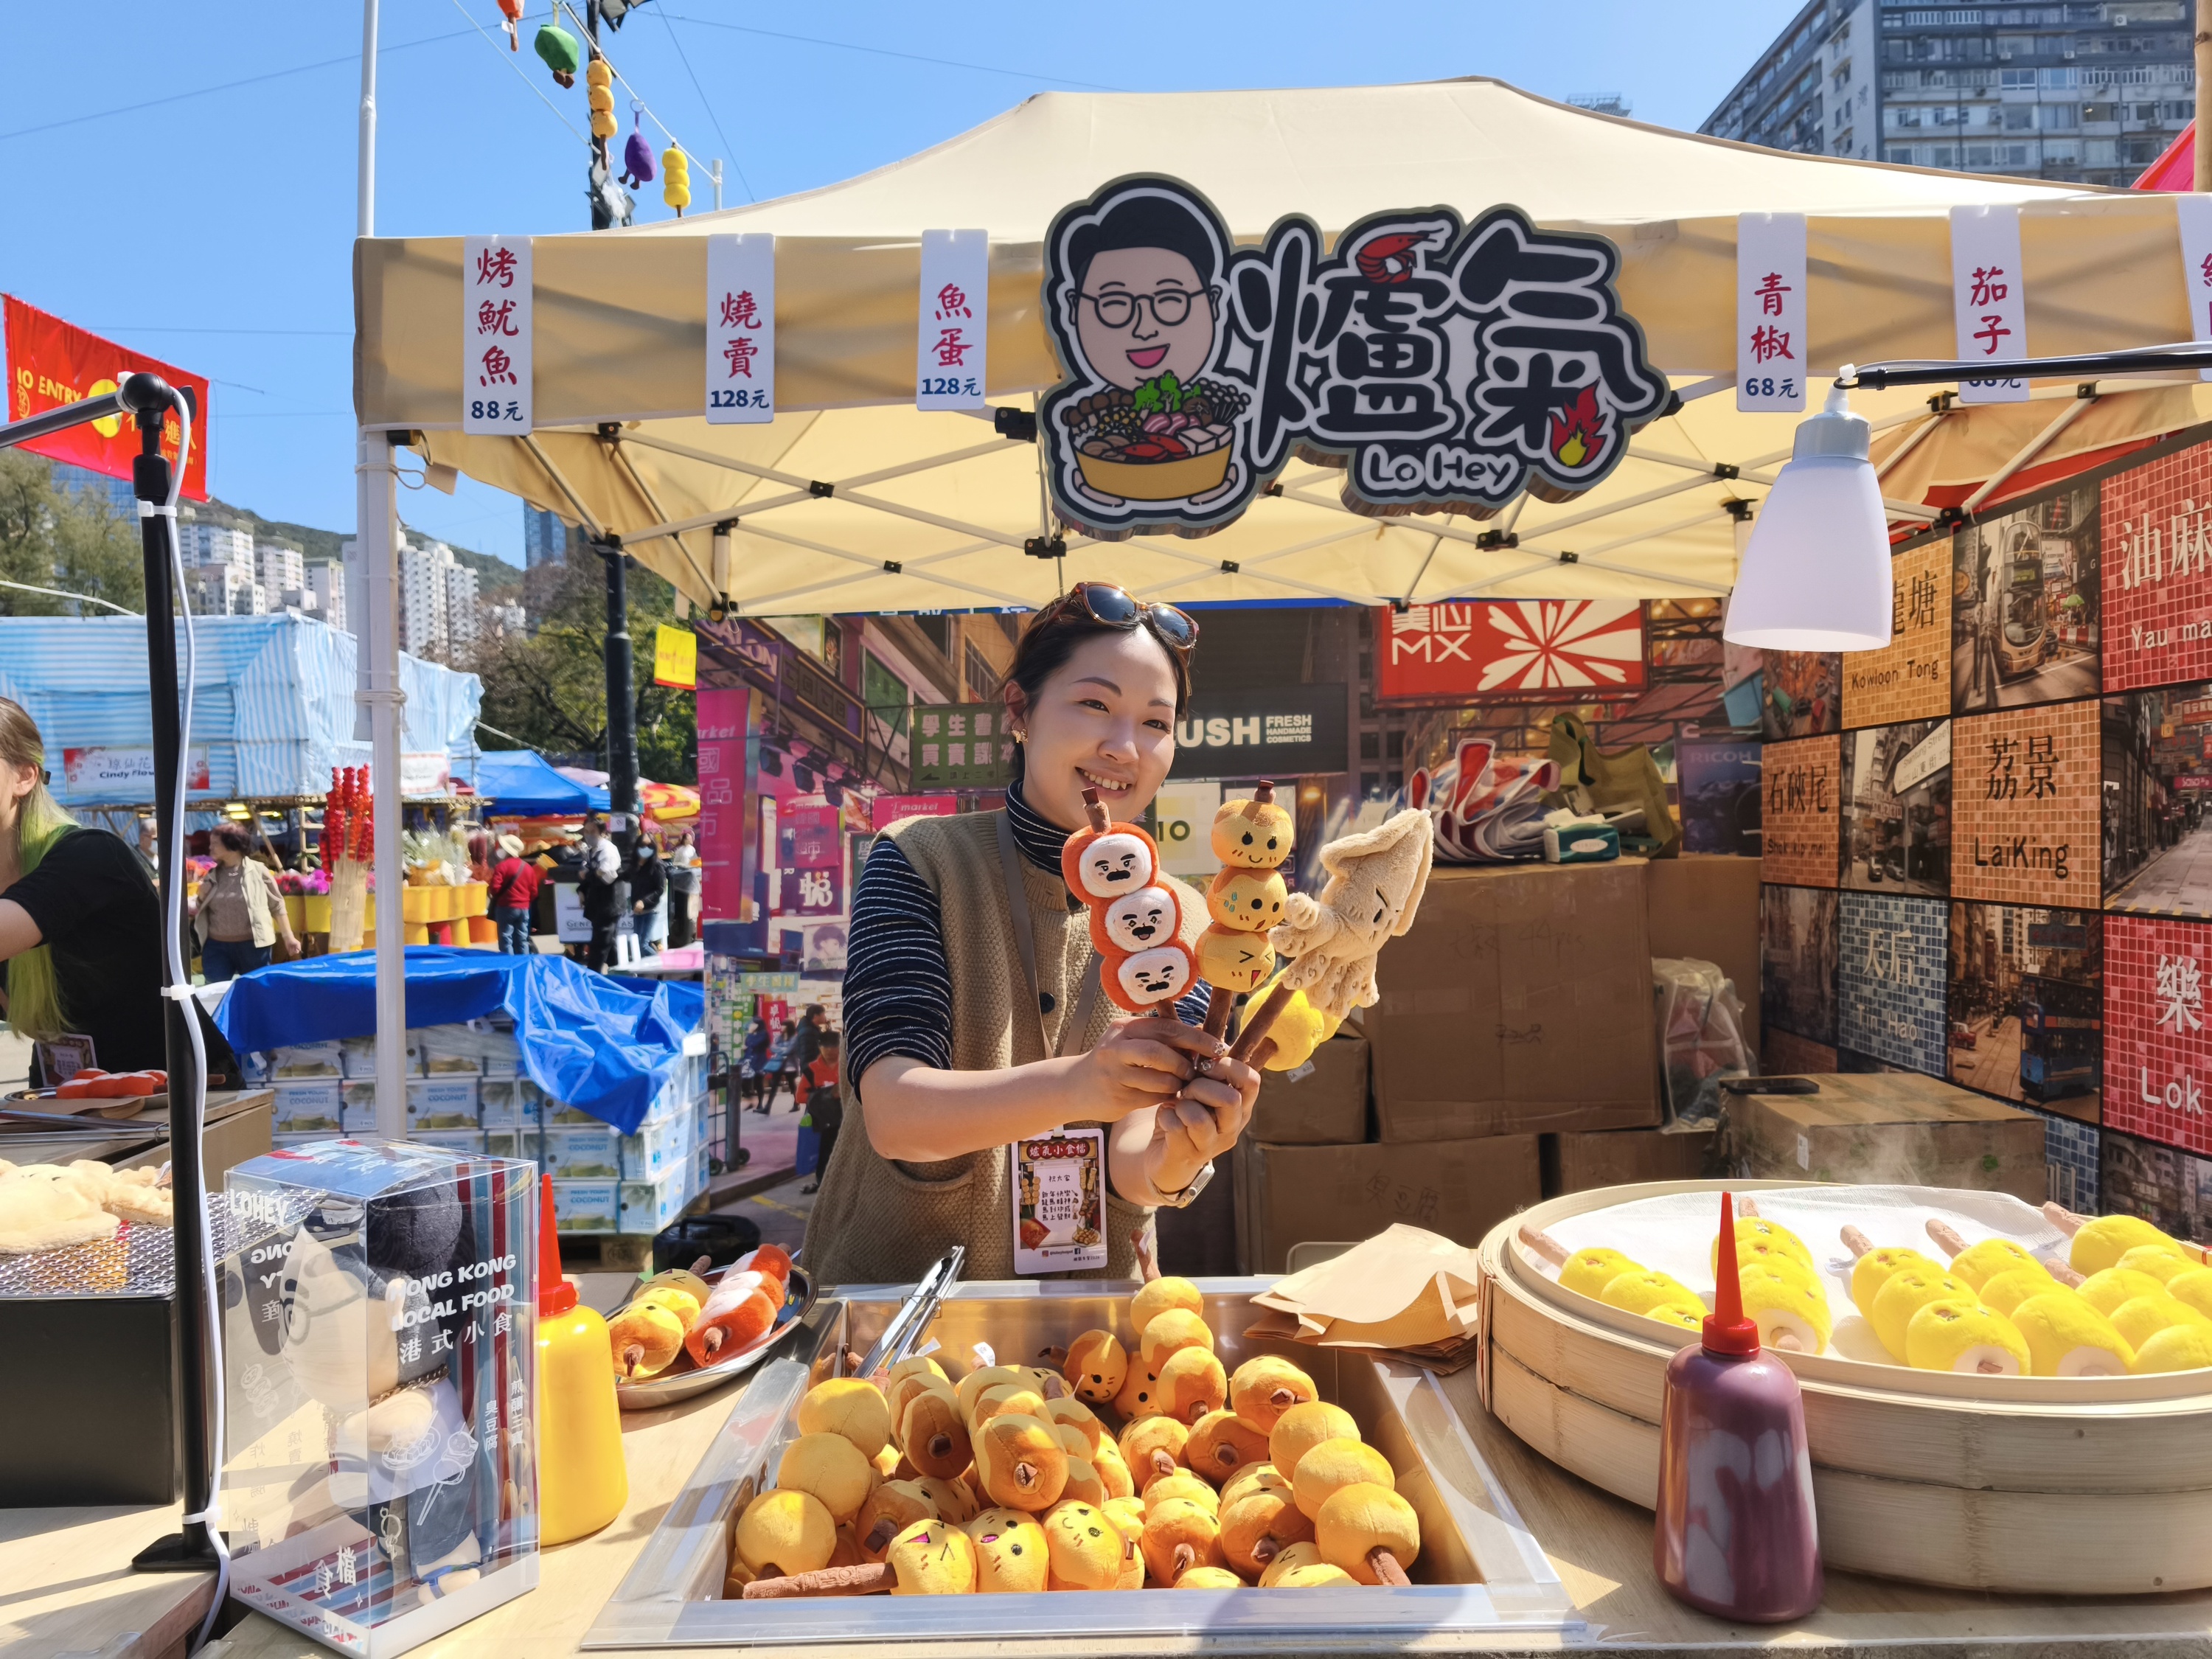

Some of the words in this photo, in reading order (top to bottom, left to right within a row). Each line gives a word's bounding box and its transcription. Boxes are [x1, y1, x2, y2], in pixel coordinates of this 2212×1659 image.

[476, 246, 518, 387] 烤魷魚
[931, 282, 974, 368] 魚蛋
[1750, 271, 1795, 364] 青椒
[1969, 265, 2011, 355] 茄子
[720, 290, 763, 380] 燒賣
[38, 375, 82, 403] ENTRY
[710, 388, 771, 411] 128元
[921, 377, 982, 398] 128元
[1745, 377, 1799, 399] 68元
[470, 400, 525, 423] 88元
[2120, 498, 2212, 590] 油麻
[1391, 604, 1472, 635] 美心
[1391, 633, 1472, 666] MX
[2131, 625, 2168, 651] Yau
[1907, 658, 1939, 680] Tong
[1176, 717, 1260, 748] USH
[1265, 714, 1312, 728] FRESH
[1265, 727, 1312, 736] HANDMADE
[1265, 734, 1312, 744] COSMETICS
[1691, 751, 1752, 763] RICOH
[99, 771, 130, 779] Cindy
[1861, 928, 1916, 986] 天后
[1856, 1004, 1878, 1031] Tin
[289, 1096, 329, 1105] COCONUT
[428, 1093, 467, 1102] COCONUT
[2141, 1065, 2202, 1115] Lok
[229, 1188, 289, 1228] LOHEY
[457, 1253, 517, 1284] KONG
[391, 1299, 457, 1332] LOCAL
[462, 1284, 515, 1312] FOOD
[399, 1312, 513, 1366] 港式小食
[484, 1399, 498, 1451] 臭豆腐
